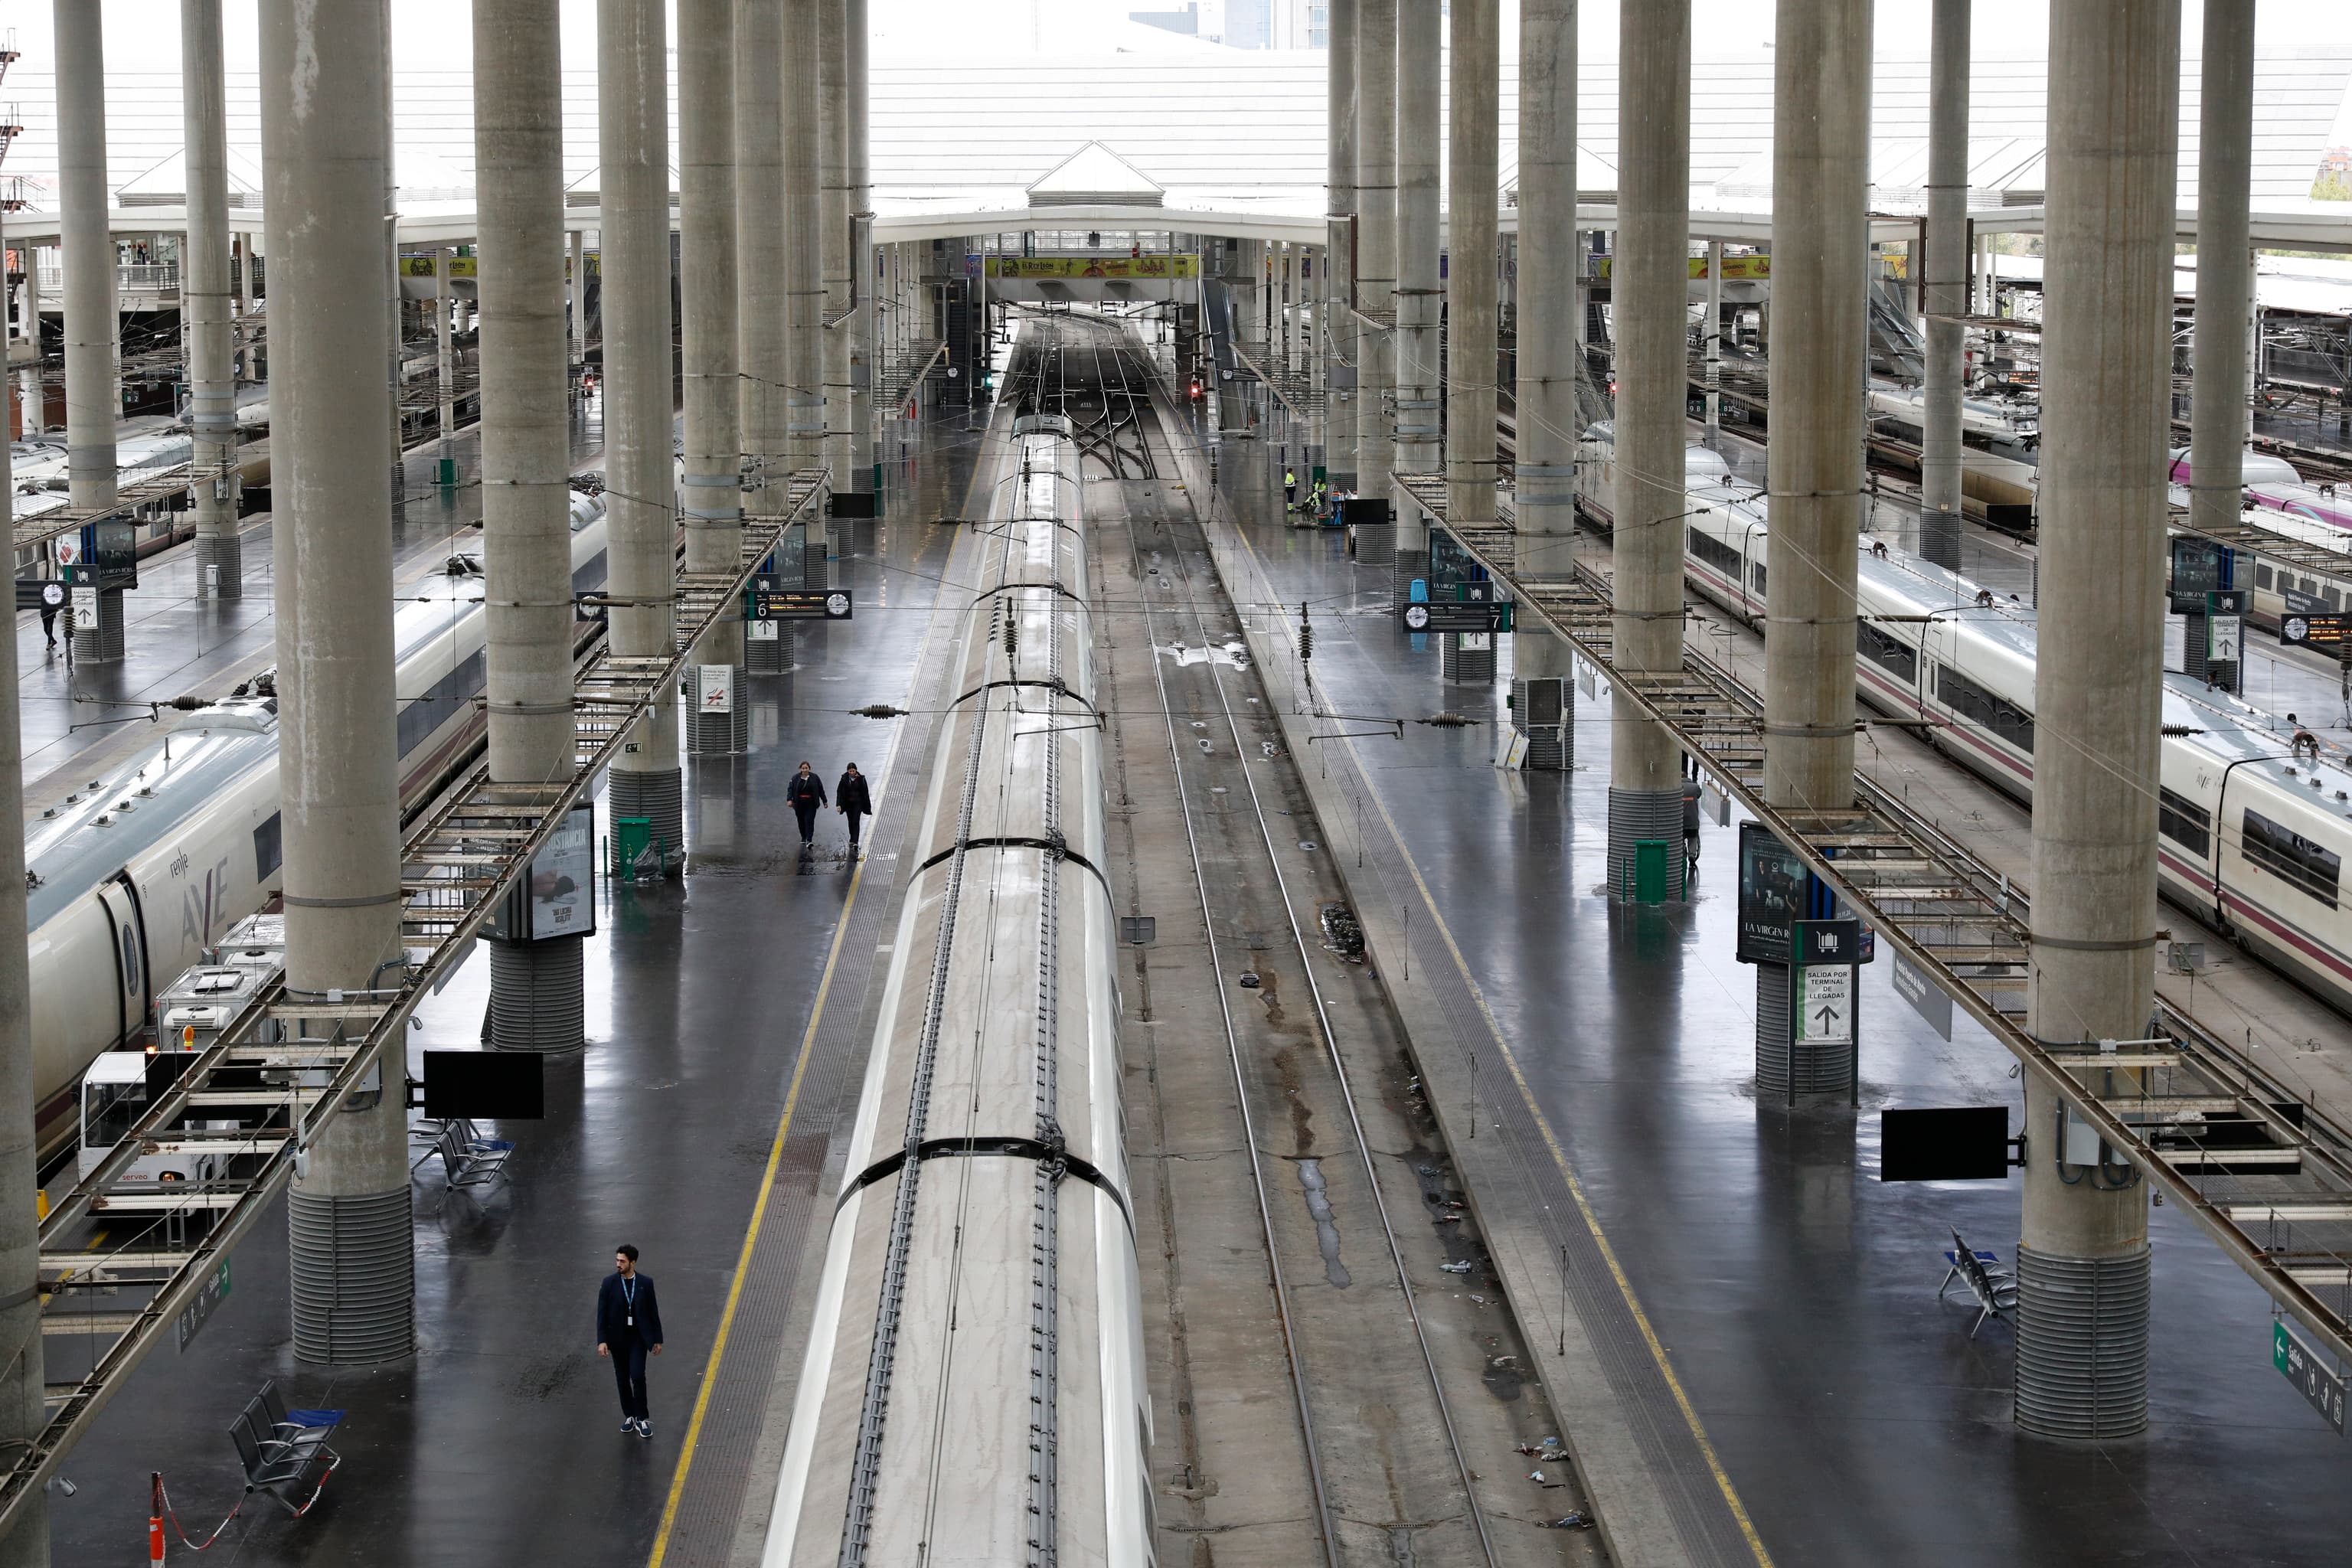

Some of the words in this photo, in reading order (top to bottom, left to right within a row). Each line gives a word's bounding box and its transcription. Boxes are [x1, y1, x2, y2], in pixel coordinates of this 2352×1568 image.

[758, 603, 766, 616] 6
[1491, 615, 1500, 629] 7
[170, 846, 189, 880] renfe
[181, 857, 228, 956] AVE
[1746, 922, 1755, 933] LA
[1756, 924, 1782, 937] VIRGEN
[2288, 1344, 2303, 1370] Salida
